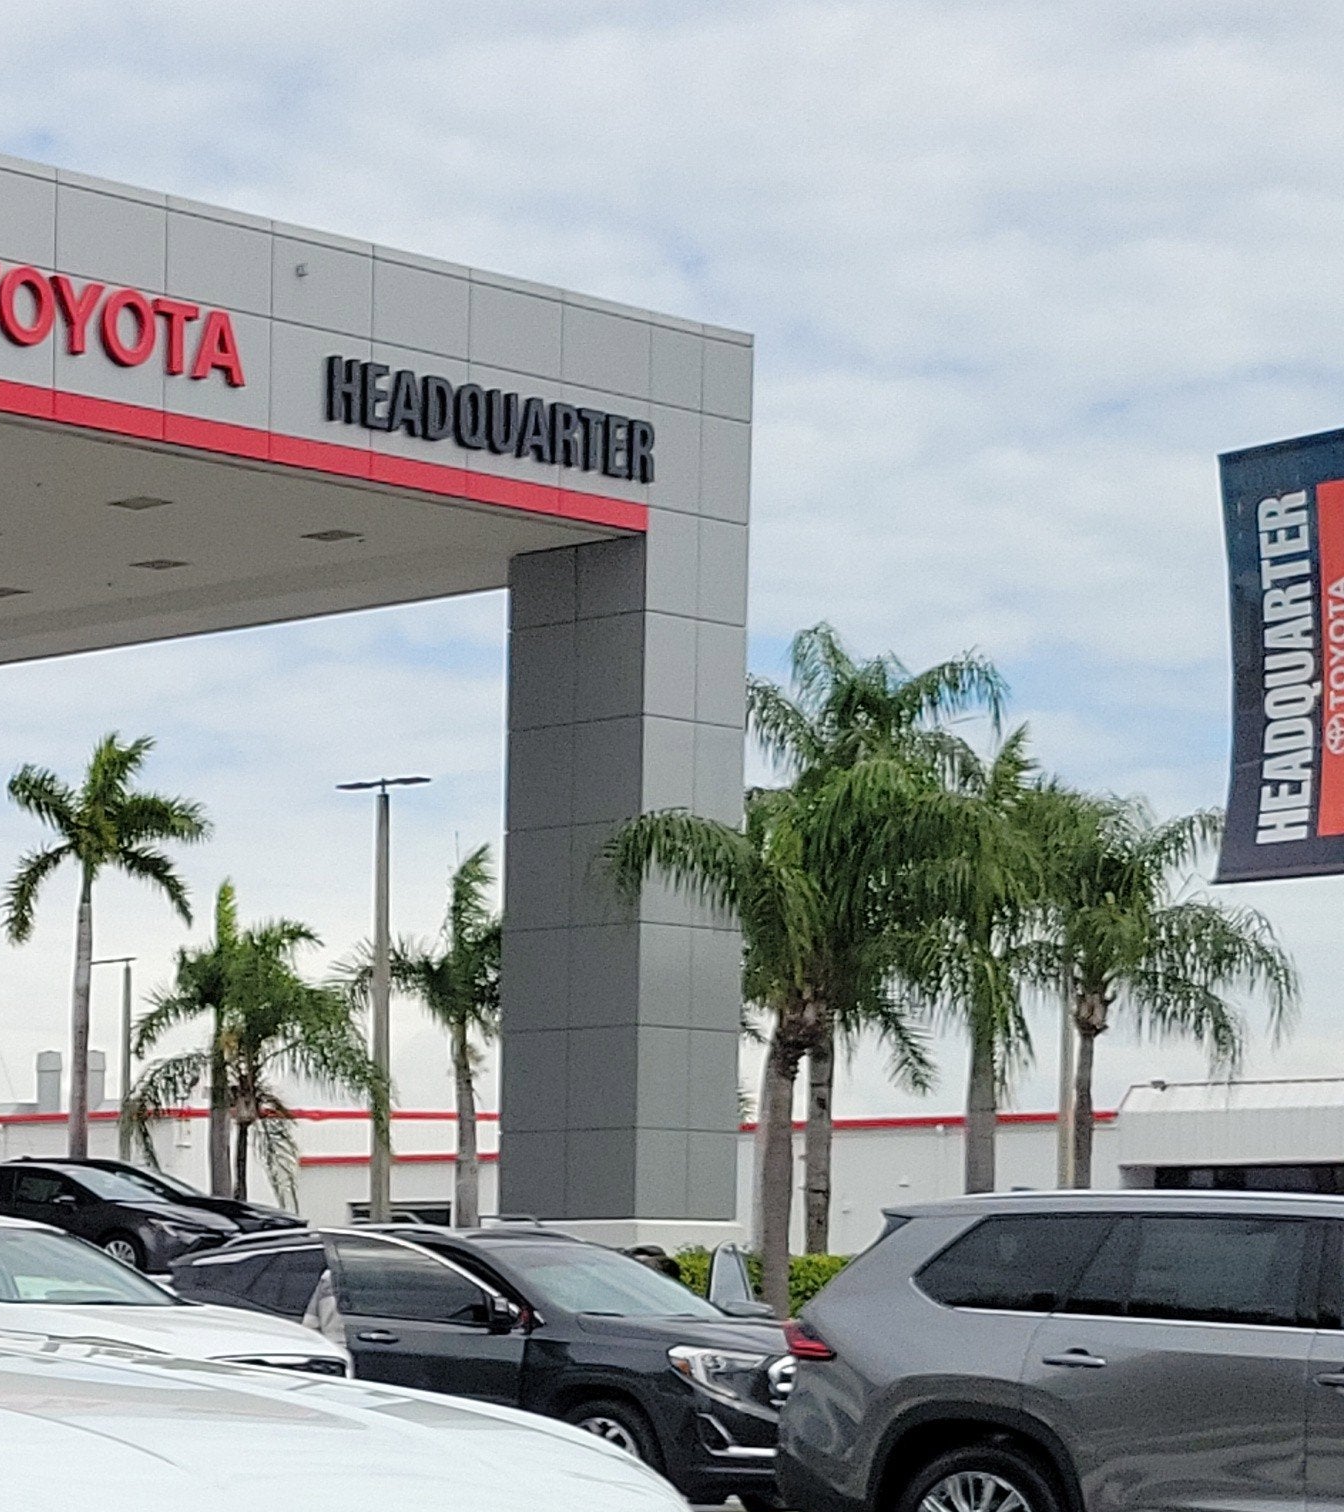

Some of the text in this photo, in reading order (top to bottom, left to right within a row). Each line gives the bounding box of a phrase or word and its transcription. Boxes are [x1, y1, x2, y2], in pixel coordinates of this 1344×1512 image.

[324, 354, 656, 484] HEADQUARTER
[1256, 489, 1322, 845] HEADQUARTER
[1327, 576, 1344, 711] TOYOTA
